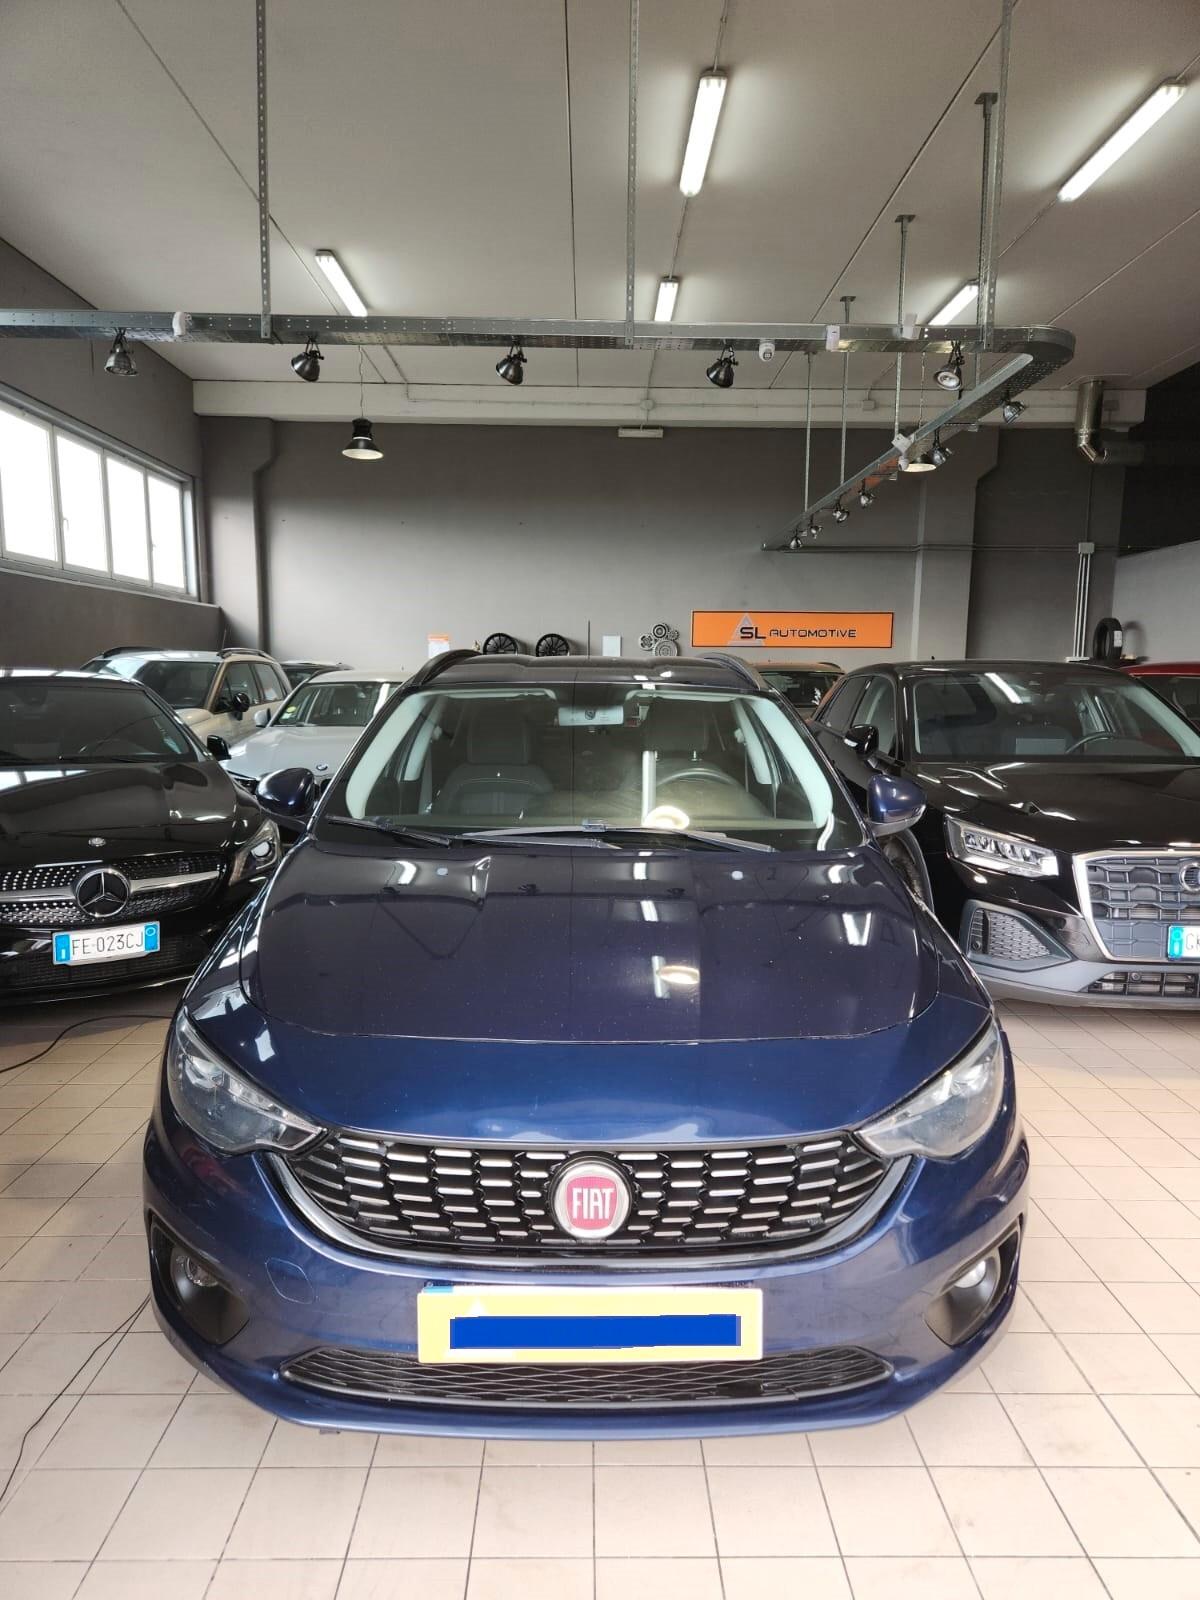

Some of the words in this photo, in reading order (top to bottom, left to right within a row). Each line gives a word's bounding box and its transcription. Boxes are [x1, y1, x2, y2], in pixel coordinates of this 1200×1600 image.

[740, 627, 766, 639] SL
[769, 629, 857, 638] AUTOMOTIVE
[72, 938, 91, 955] FE
[96, 931, 143, 952] 023CJ
[572, 1188, 615, 1219] FIAT
